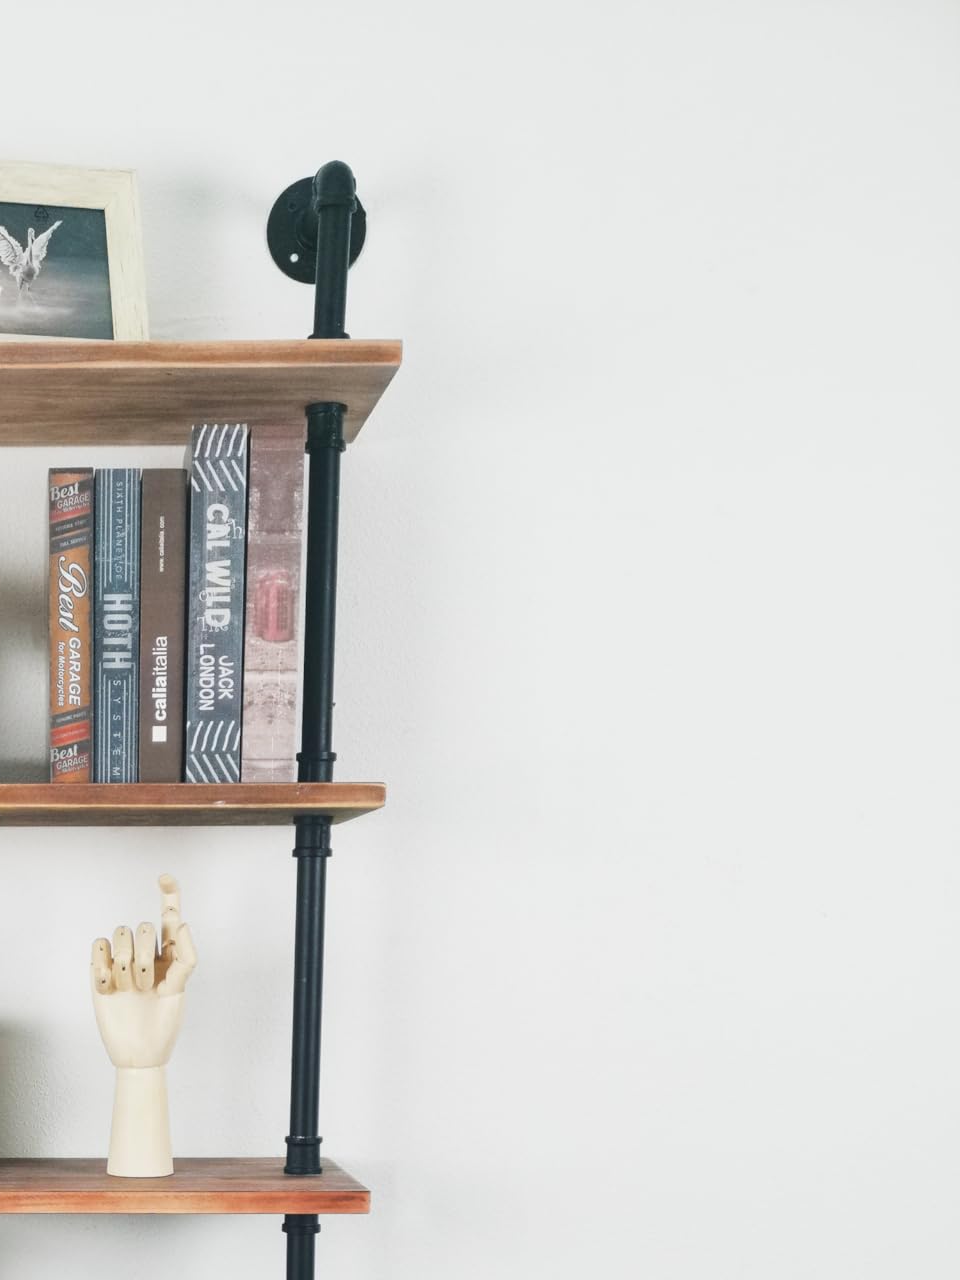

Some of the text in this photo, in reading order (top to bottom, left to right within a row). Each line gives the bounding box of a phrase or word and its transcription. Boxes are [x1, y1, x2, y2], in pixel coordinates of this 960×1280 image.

[50, 482, 79, 501] Best
[57, 494, 89, 509] GARAGE
[116, 481, 124, 512] SIXTH
[58, 556, 87, 633] Best
[205, 560, 231, 628] WILD
[102, 593, 133, 669] HOTH
[56, 641, 65, 707] for Motorcycles
[68, 637, 82, 706] GARAGE
[152, 636, 167, 721] caliaitalia
[199, 644, 215, 711] LONDON
[218, 656, 234, 699] JACK
[50, 744, 78, 763] Best
[112, 680, 122, 776] SYSTEM
[57, 754, 89, 769] GARAGE
